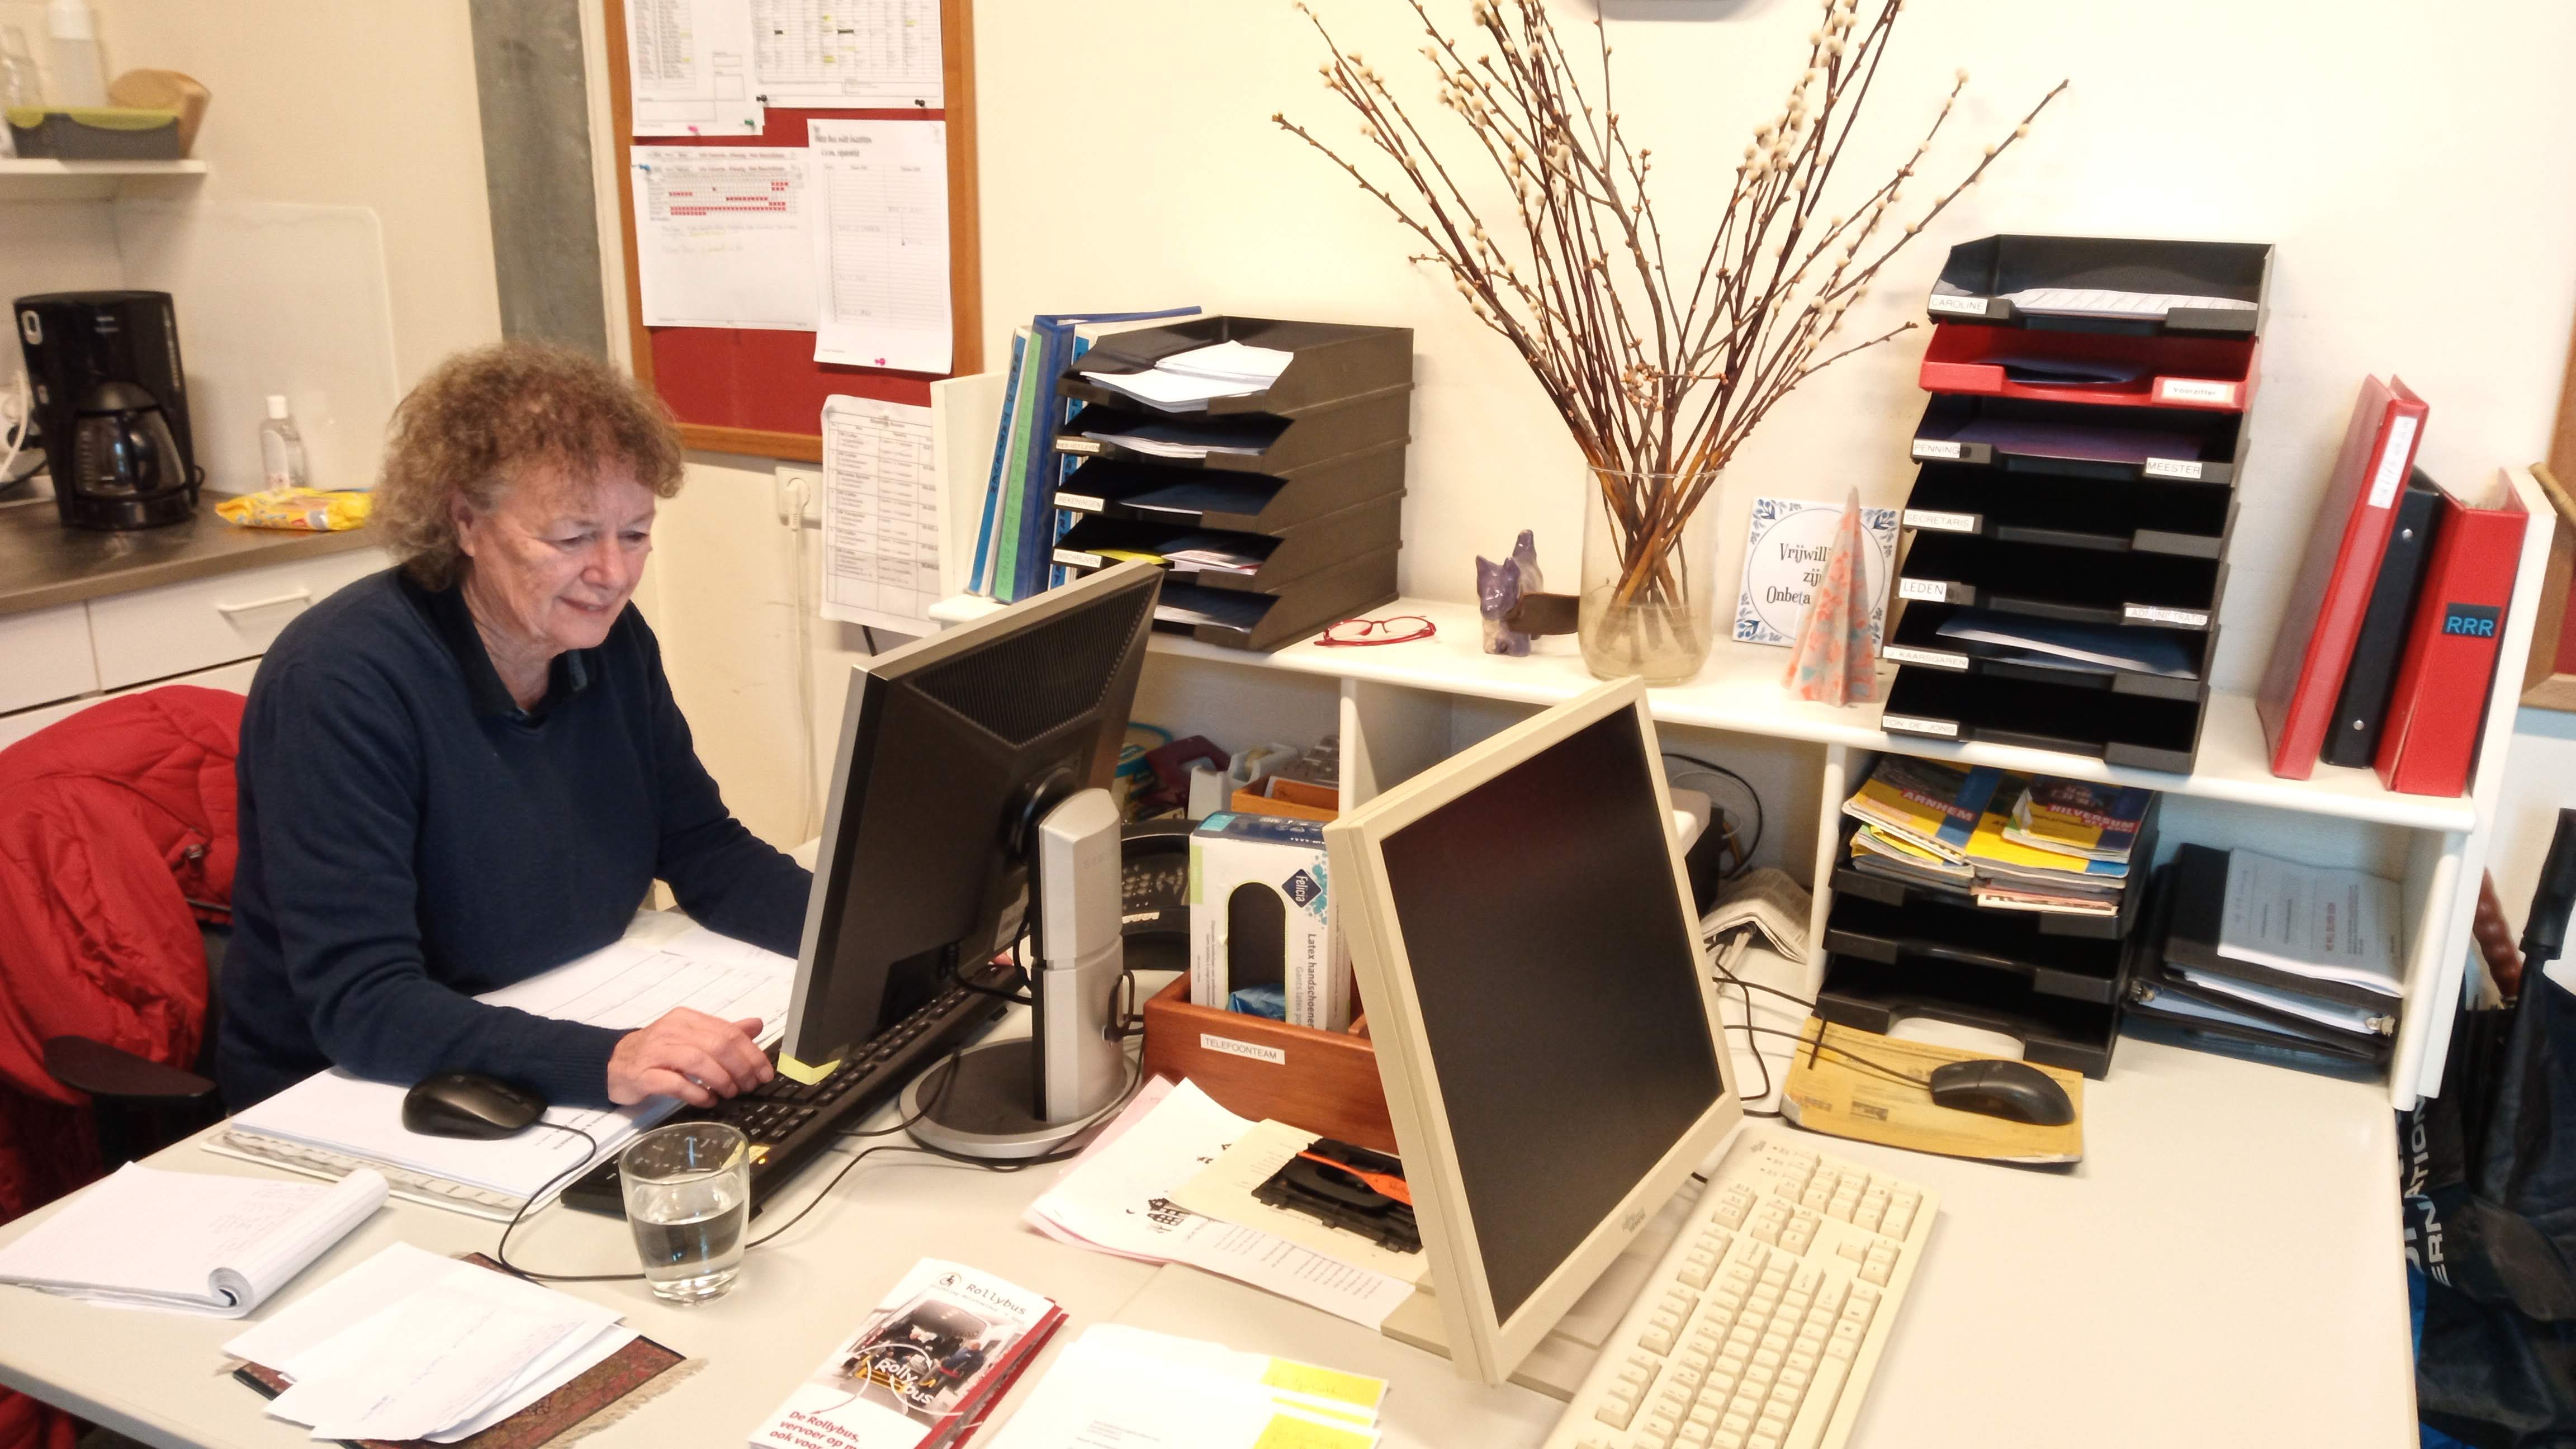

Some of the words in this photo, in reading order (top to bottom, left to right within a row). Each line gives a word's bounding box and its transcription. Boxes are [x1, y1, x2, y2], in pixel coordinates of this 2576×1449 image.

[1932, 299, 1983, 310] CAROLINE
[2174, 387, 2217, 396] Voorzitter
[1915, 443, 1960, 454] PENNING
[2147, 461, 2200, 475] MEESTER
[1058, 496, 1101, 508] REKENINGEN
[1906, 513, 1969, 528] SECRETARIS
[1802, 568, 1822, 587] zij
[1904, 581, 1944, 595] LEDEN
[2446, 615, 2494, 636] RRR
[1930, 724, 1955, 733] JONG
[1903, 790, 1974, 821] ARNHEM
[2051, 804, 2135, 828] HILVERSUM
[1296, 875, 1308, 902] Felicia
[1308, 934, 1317, 960] Latex
[1205, 1038, 1277, 1059] TELEFOONTEAM
[966, 1284, 1026, 1315] Rollybus
[874, 1358, 918, 1385] Rolly
[903, 1381, 935, 1405] bus
[769, 1431, 794, 1442] ook
[780, 1421, 826, 1439] vervoer
[826, 1437, 844, 1447] op
[789, 1411, 806, 1420] De
[807, 1416, 859, 1443] Rollybus,
